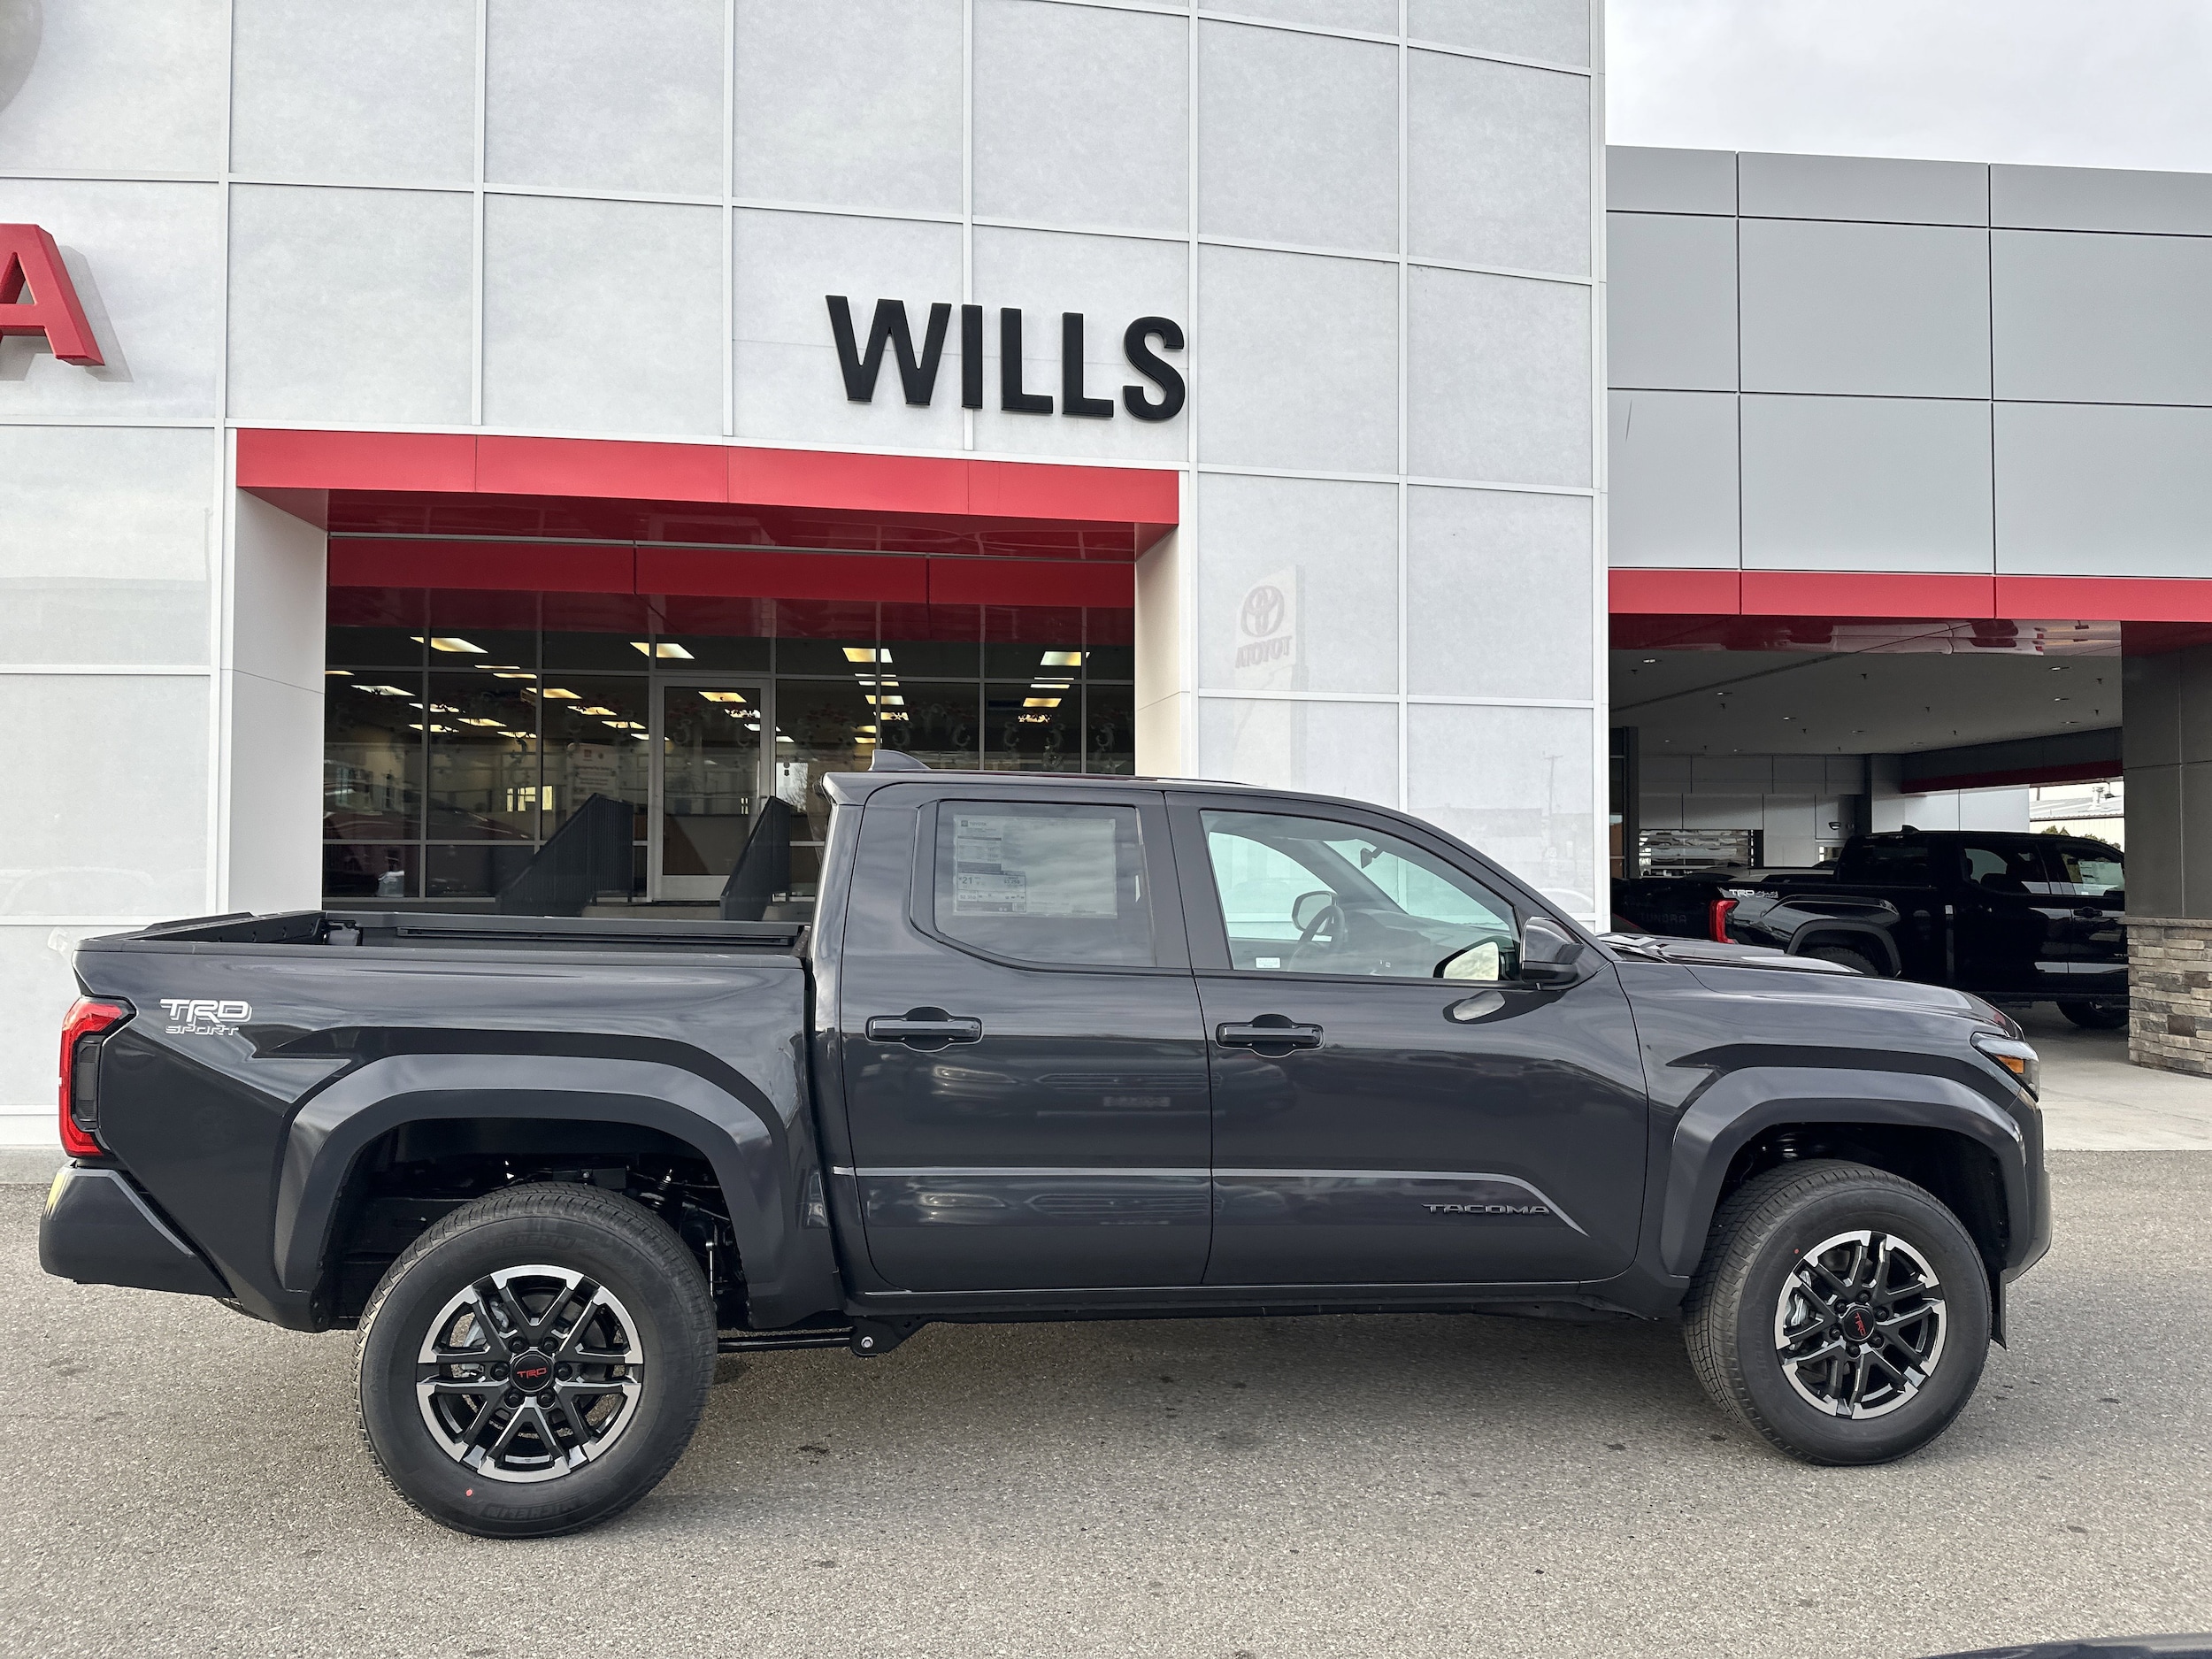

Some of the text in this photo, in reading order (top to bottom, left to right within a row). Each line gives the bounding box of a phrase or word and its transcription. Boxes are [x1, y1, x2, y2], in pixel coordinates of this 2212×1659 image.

[825, 295, 1186, 421] WILLS
[962, 876, 972, 885] 21
[1728, 889, 1755, 898] TRD
[1639, 912, 1686, 924] TUNDRA
[160, 998, 252, 1027] TRD
[165, 1025, 240, 1036] SPORT
[1421, 1203, 1550, 1215] TACOMA
[1854, 1311, 1867, 1336] TRD
[516, 1366, 548, 1379] TRD
